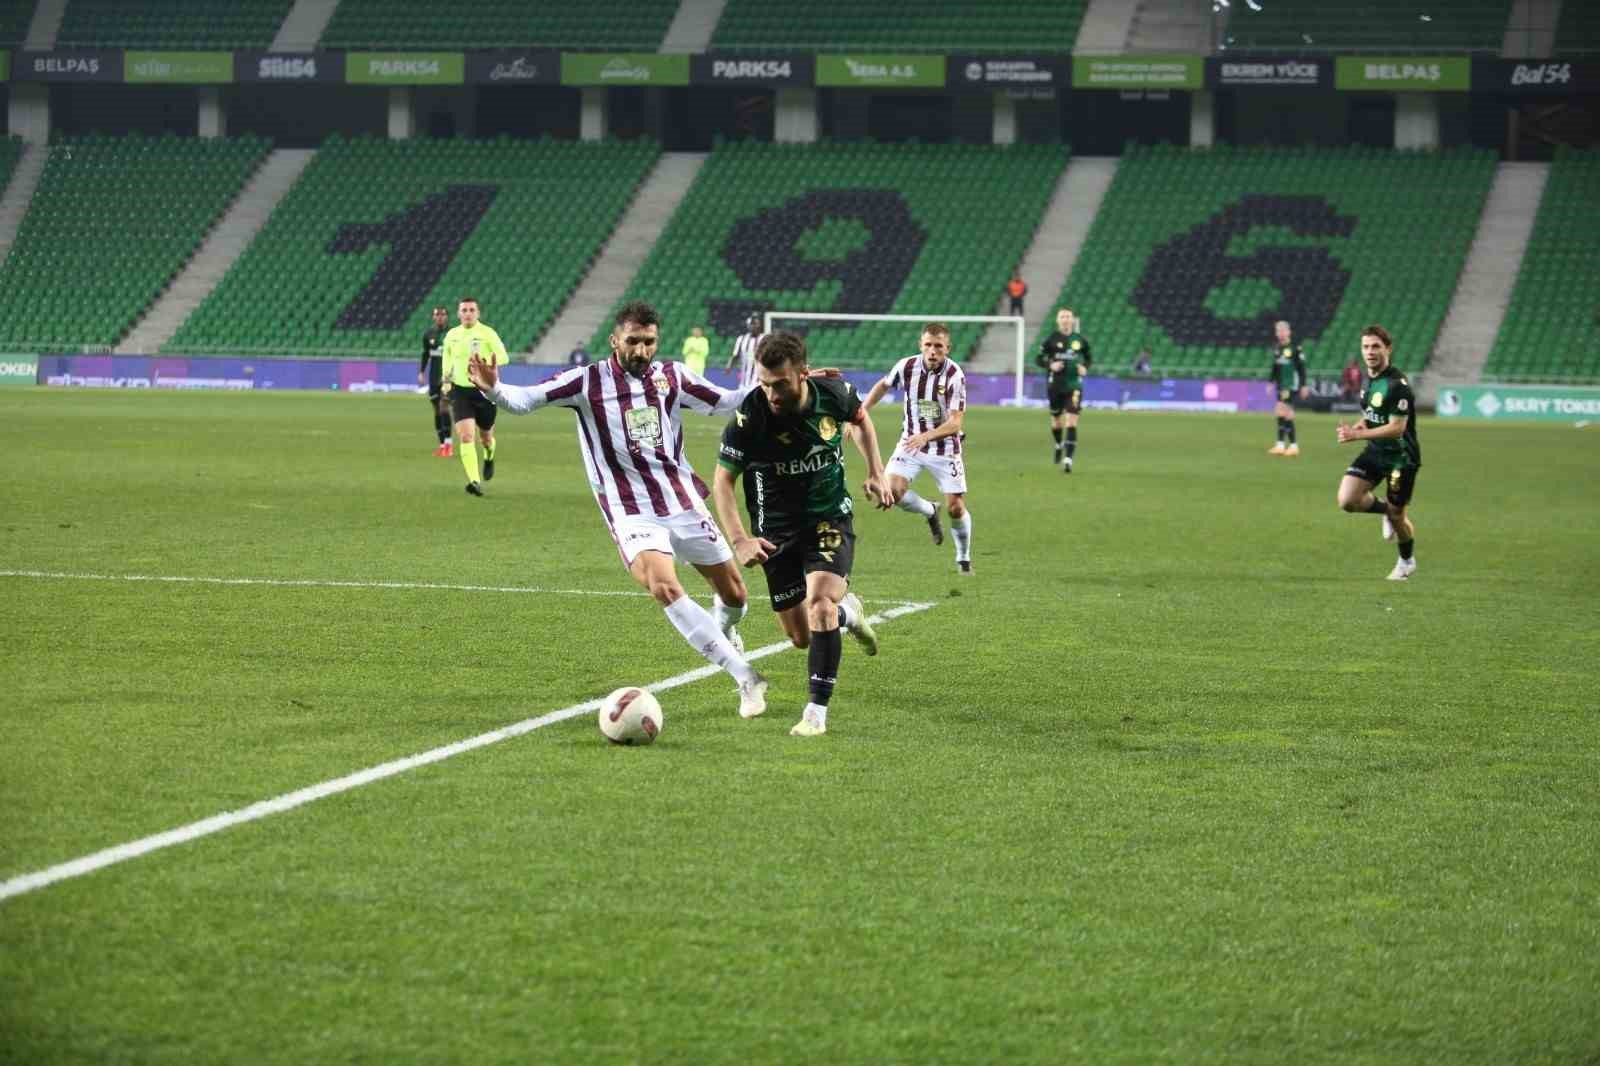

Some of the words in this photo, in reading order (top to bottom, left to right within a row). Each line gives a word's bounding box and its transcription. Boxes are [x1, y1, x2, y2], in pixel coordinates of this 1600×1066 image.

[33, 58, 99, 75] BELPAŞ
[368, 59, 440, 76] PARK54
[712, 60, 792, 79] PARK54
[1364, 63, 1442, 81] BELPAŞ
